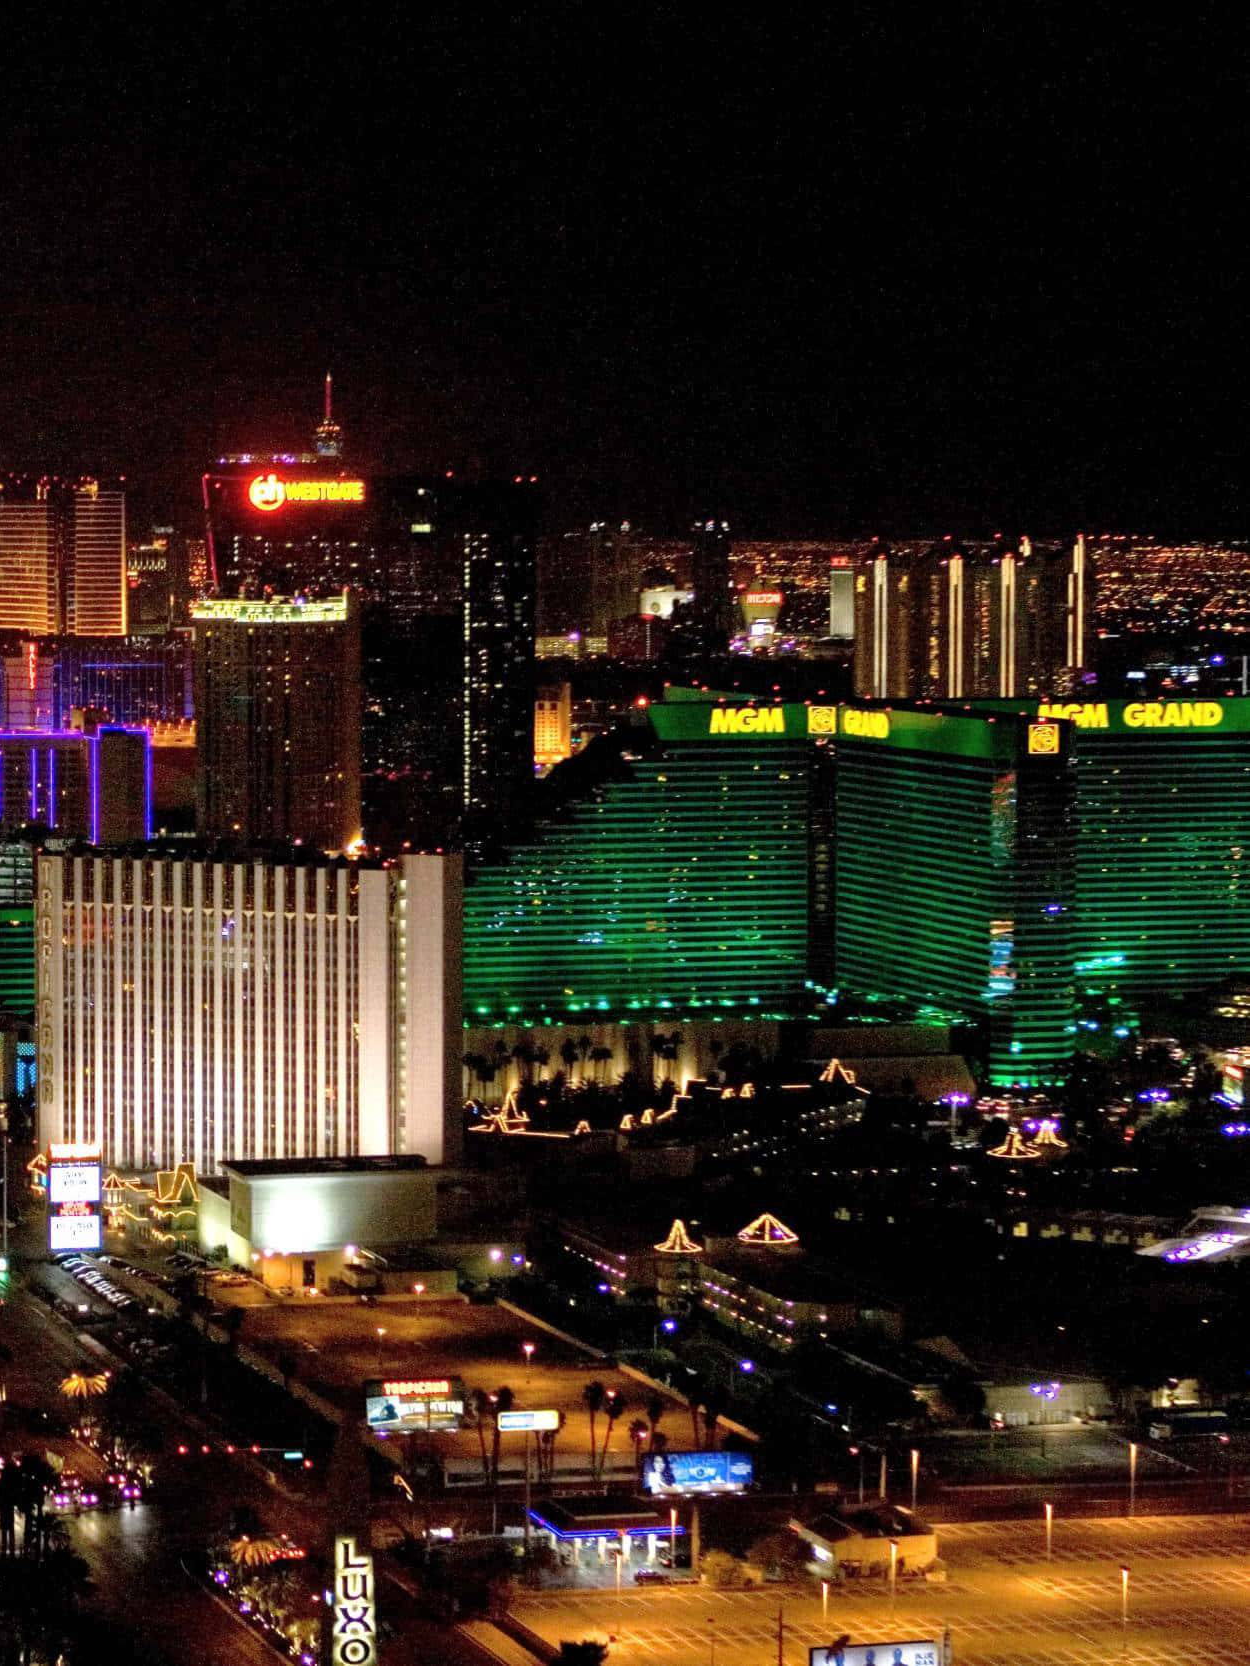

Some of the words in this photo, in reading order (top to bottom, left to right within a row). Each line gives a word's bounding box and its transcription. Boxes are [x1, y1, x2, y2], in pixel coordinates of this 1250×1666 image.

[285, 482, 365, 501] WESTGATE
[709, 707, 785, 733] MGM
[843, 710, 890, 739] GRAND
[1038, 703, 1110, 728] MGM
[1123, 702, 1224, 728] GRAND
[384, 1381, 449, 1395] TROPICANA
[336, 1540, 374, 1665] LUXO
